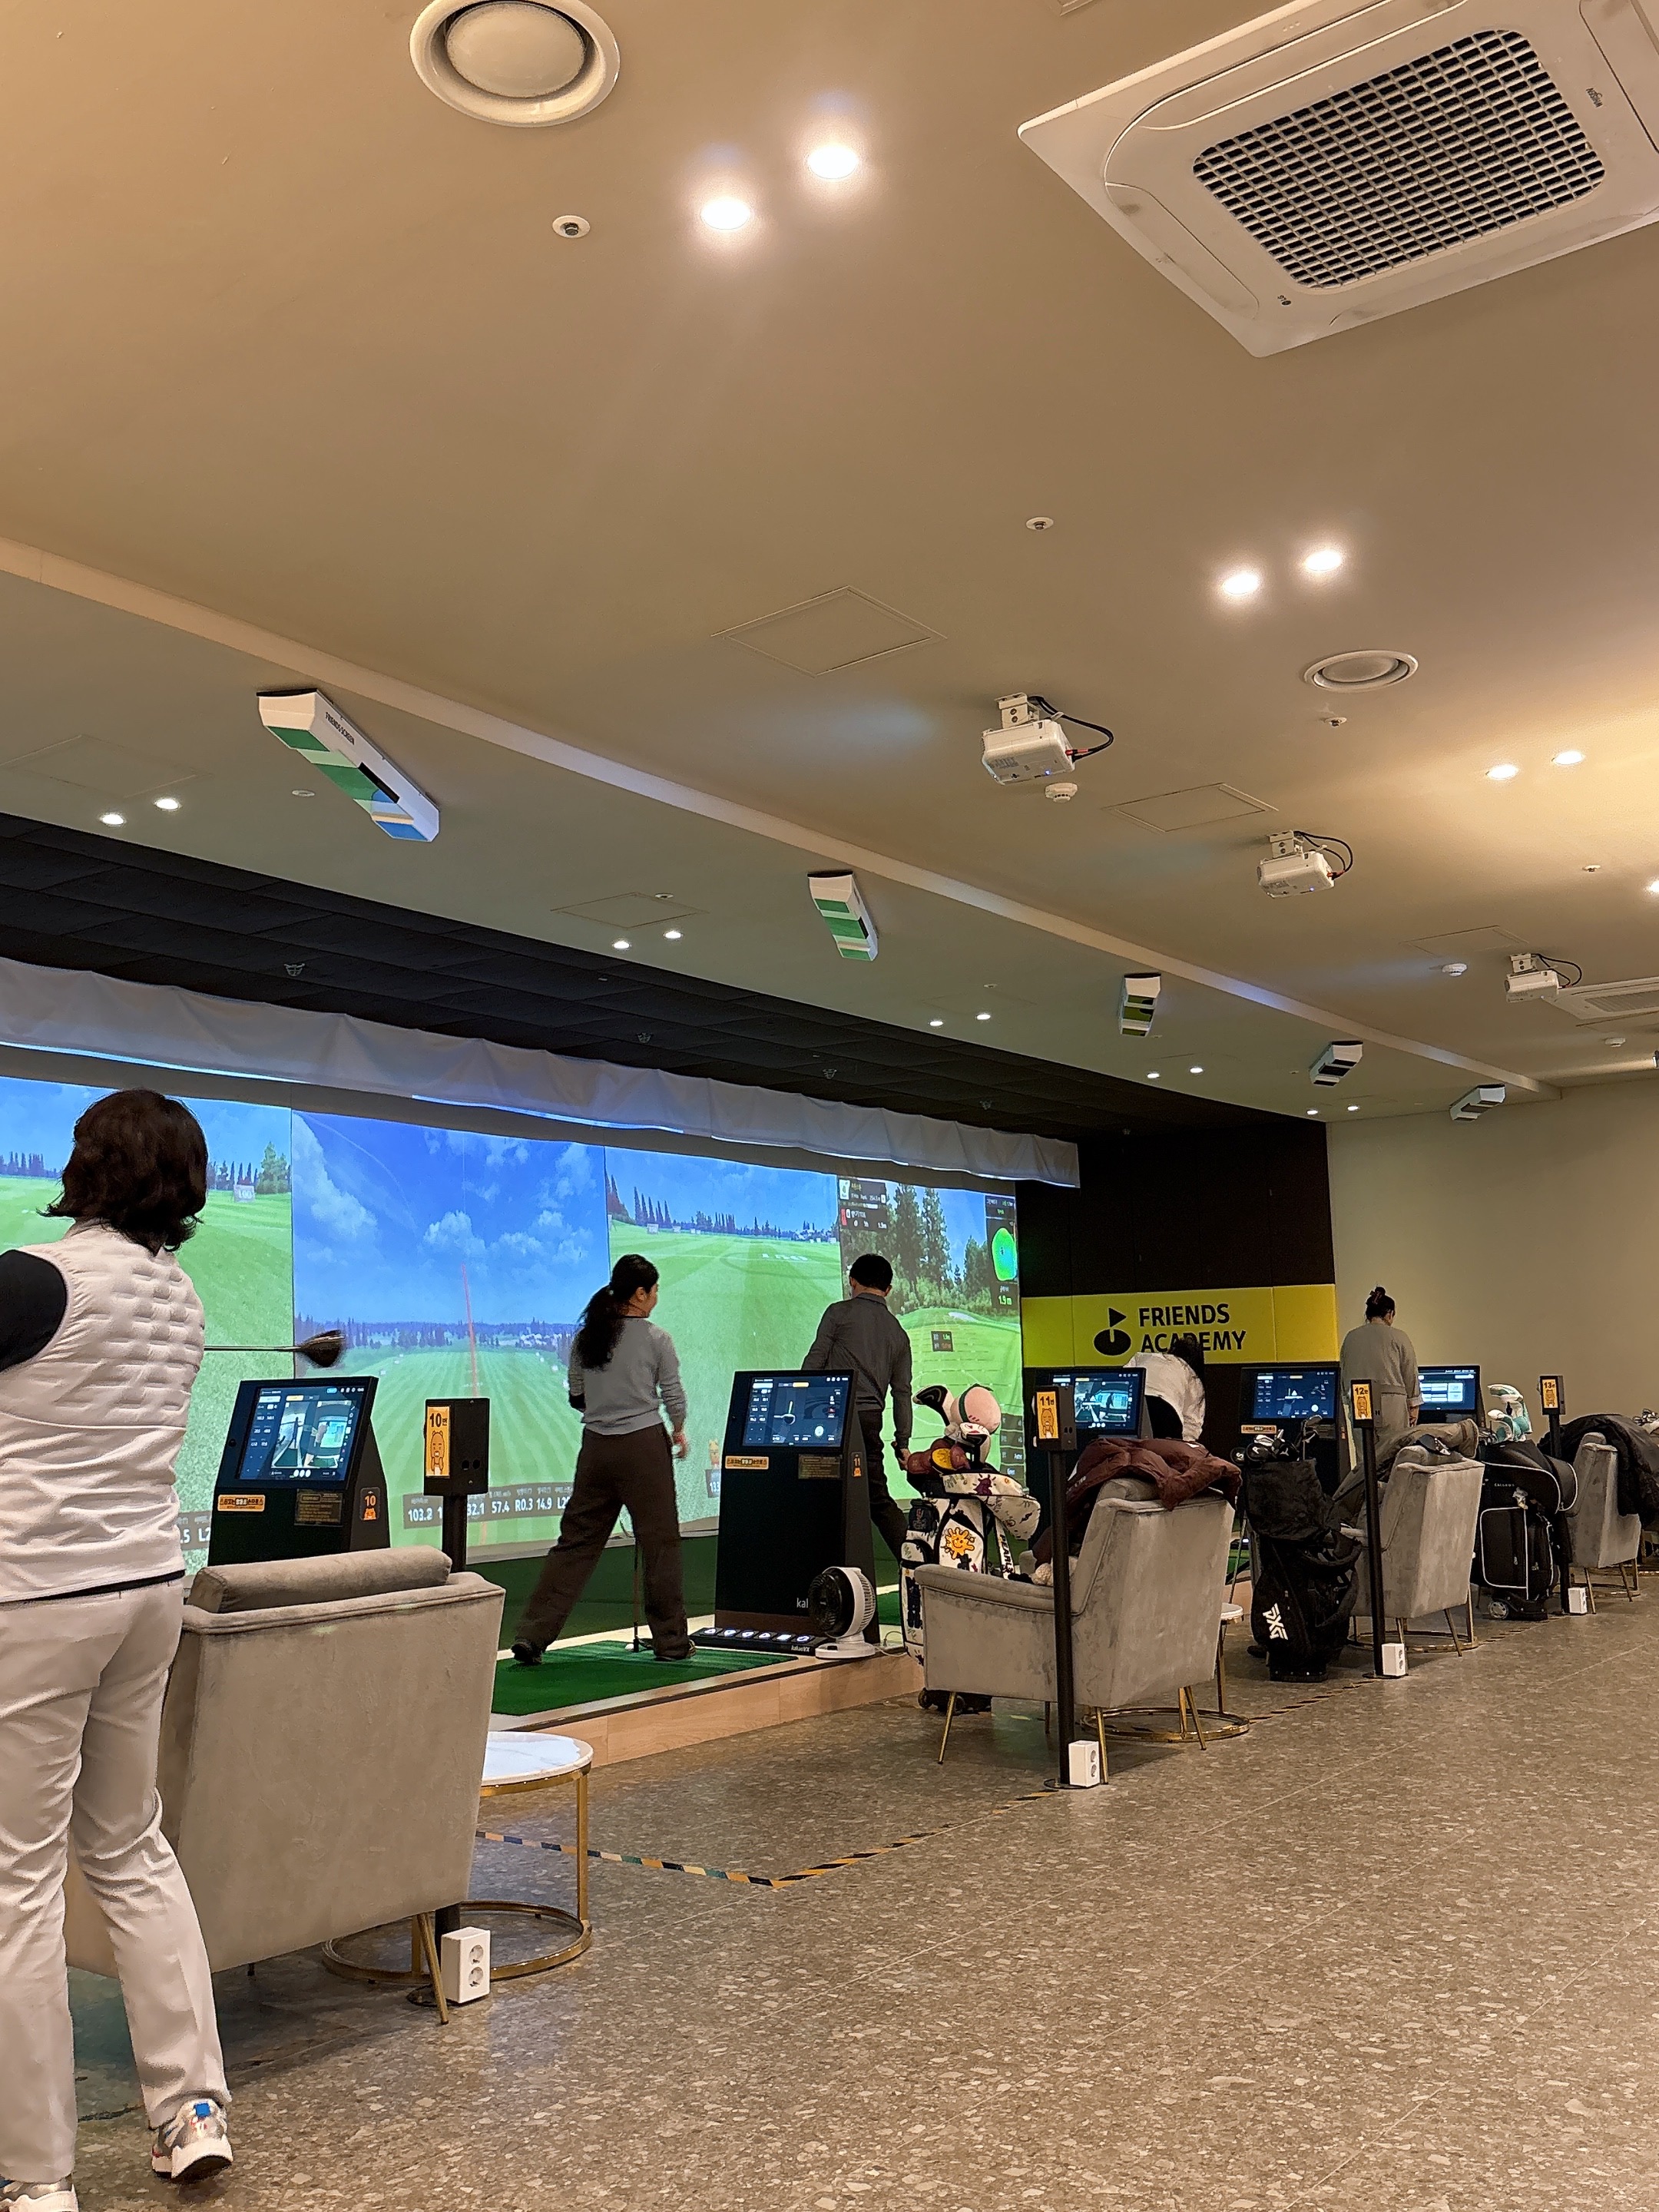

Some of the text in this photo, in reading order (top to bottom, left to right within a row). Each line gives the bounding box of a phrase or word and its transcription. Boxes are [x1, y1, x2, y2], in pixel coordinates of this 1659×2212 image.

[1138, 1303, 1230, 1327] FRIENDS
[853, 1458, 861, 1468] 11
[364, 1495, 376, 1507] 10
[491, 1500, 510, 1514] 57.4
[515, 1498, 533, 1512] R0.3
[536, 1497, 552, 1511] 14.9
[1262, 1602, 1289, 1641] PXG
